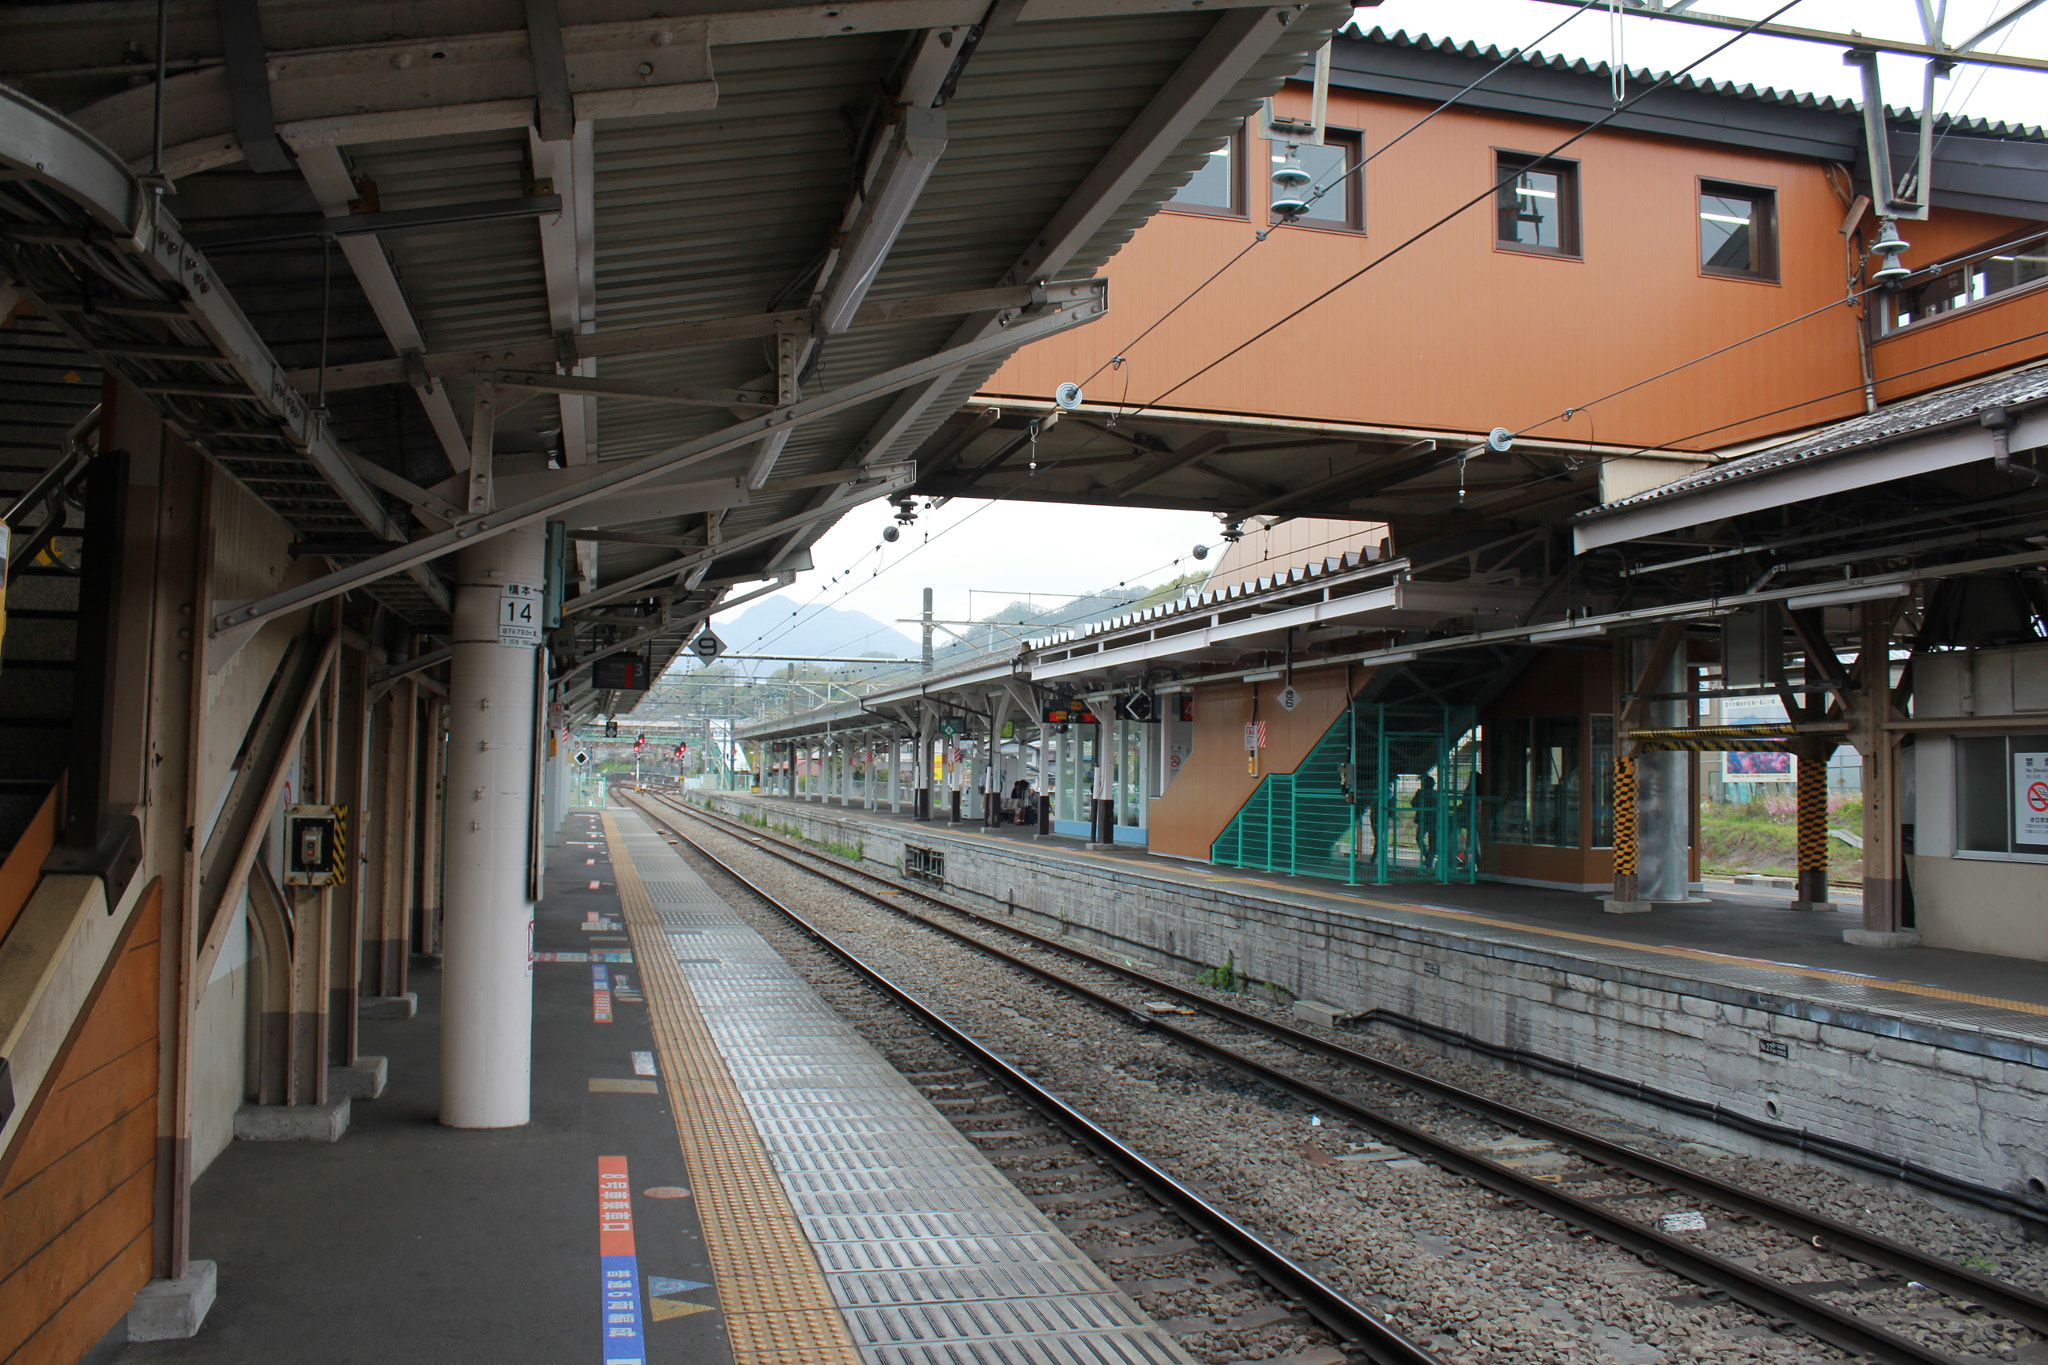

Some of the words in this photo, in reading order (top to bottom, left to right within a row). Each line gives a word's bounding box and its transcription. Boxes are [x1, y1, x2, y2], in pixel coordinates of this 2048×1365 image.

[508, 602, 532, 623] 14
[698, 637, 717, 656] 9
[635, 663, 643, 677] 3
[1184, 702, 1193, 716] 4
[601, 1173, 630, 1232] 8号車乗車口
[606, 1270, 637, 1338] 普通6両編成
